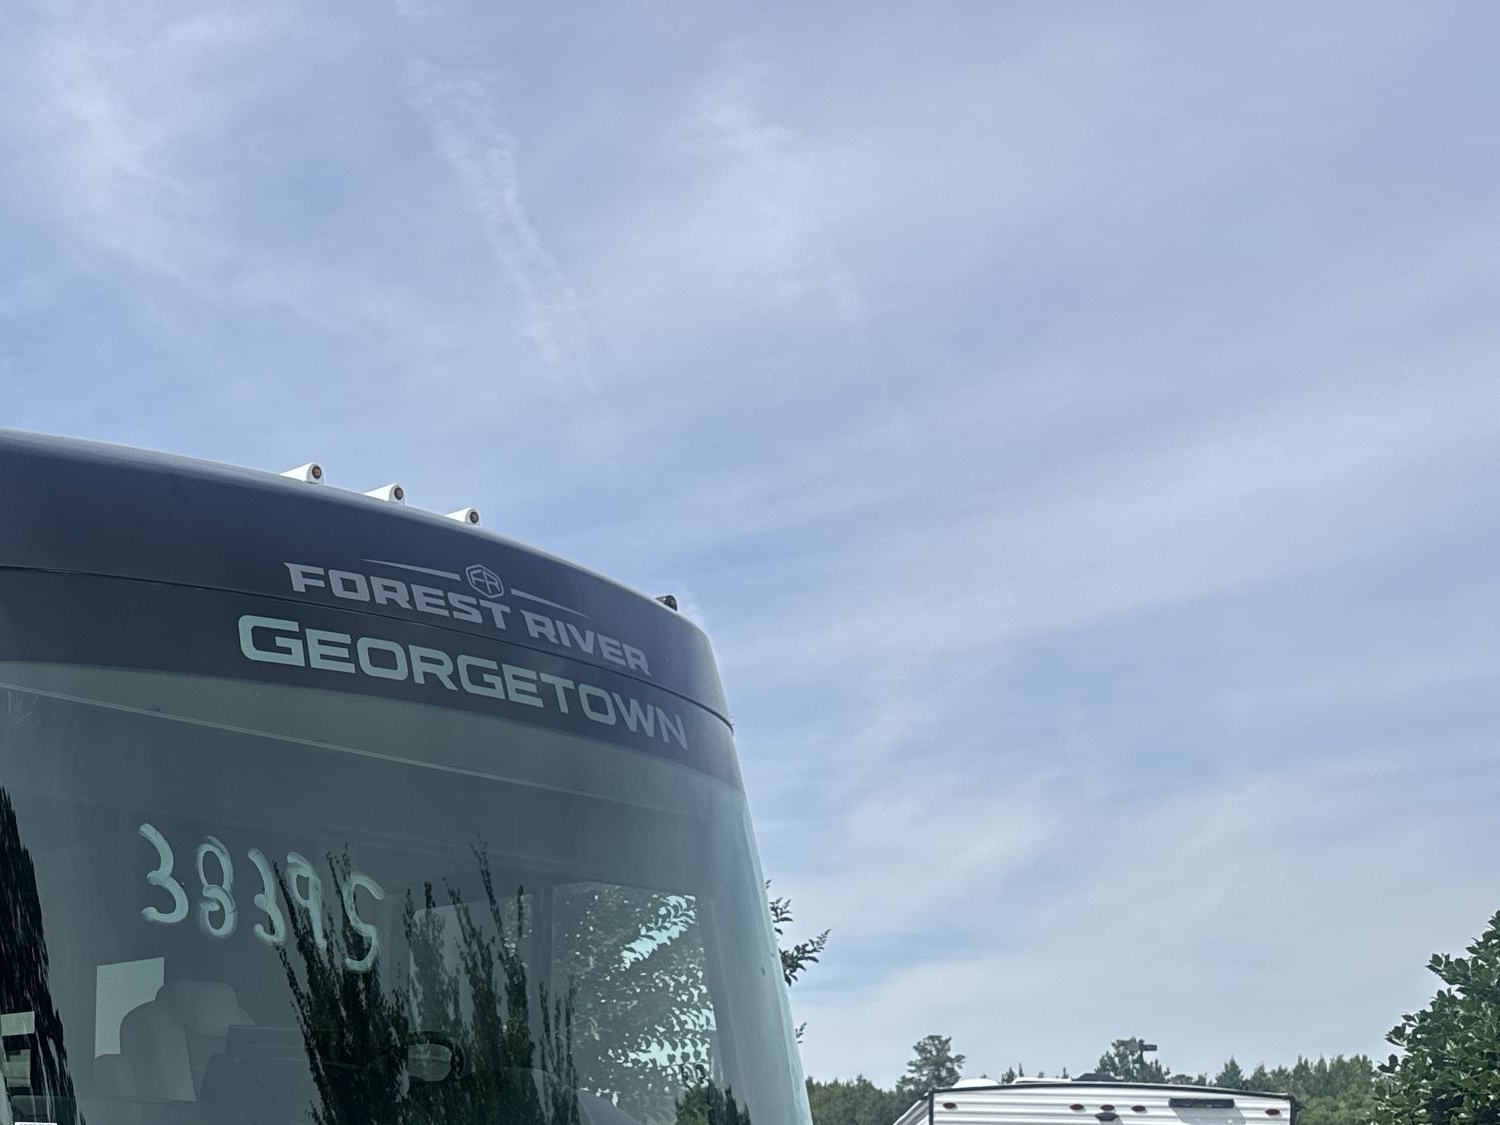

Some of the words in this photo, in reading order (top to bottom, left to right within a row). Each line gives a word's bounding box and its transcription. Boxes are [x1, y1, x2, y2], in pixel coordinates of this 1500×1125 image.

[237, 614, 689, 750] GEORGETOWN
[283, 561, 512, 630] FOREST
[519, 609, 652, 677] RIVER
[139, 822, 386, 972] 38395
